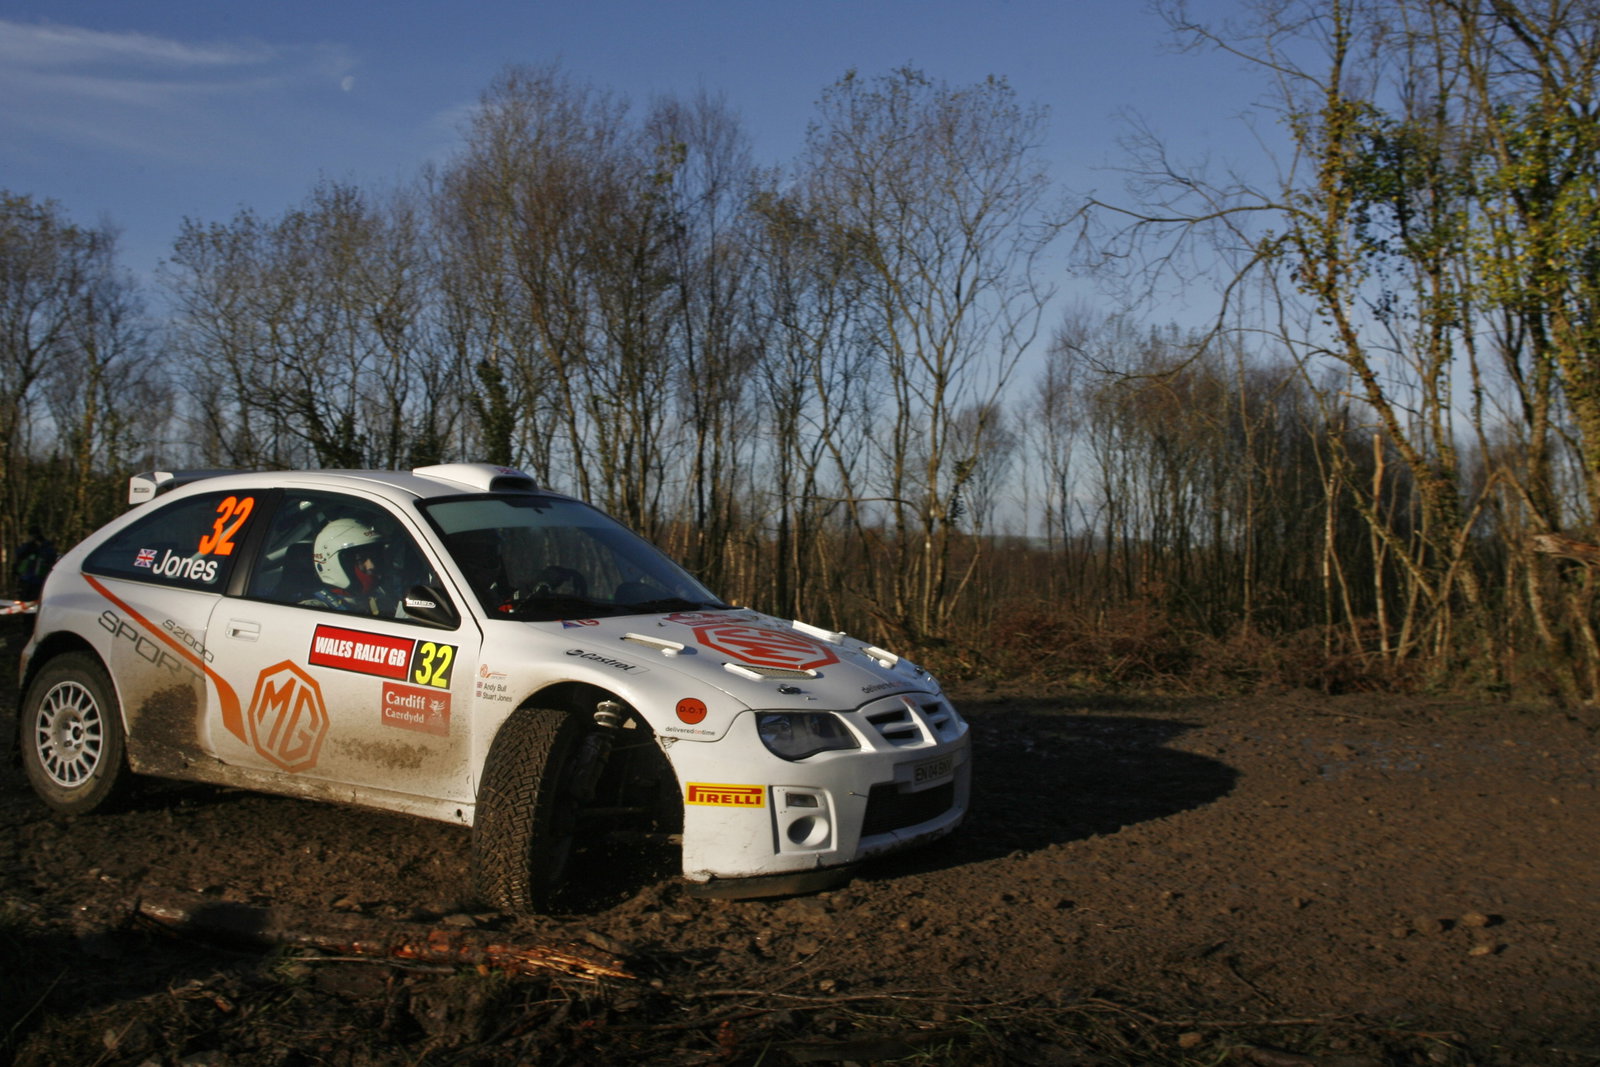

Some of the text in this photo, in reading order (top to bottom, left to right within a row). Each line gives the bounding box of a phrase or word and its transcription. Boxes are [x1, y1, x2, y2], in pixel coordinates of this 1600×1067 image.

[198, 496, 255, 556] 32
[152, 549, 218, 581] Jones
[98, 610, 206, 685] SPORT
[162, 619, 214, 664] S2000
[315, 636, 407, 667] WALES RALLY GB
[415, 641, 453, 688] 32
[580, 653, 636, 671] Castrol
[386, 691, 426, 710] Cardiff
[482, 692, 512, 703] Stuart Jones
[483, 683, 496, 692] Andy
[256, 675, 320, 763] MG
[385, 708, 425, 724] Caerdydd
[688, 785, 763, 805] PIRELLI
